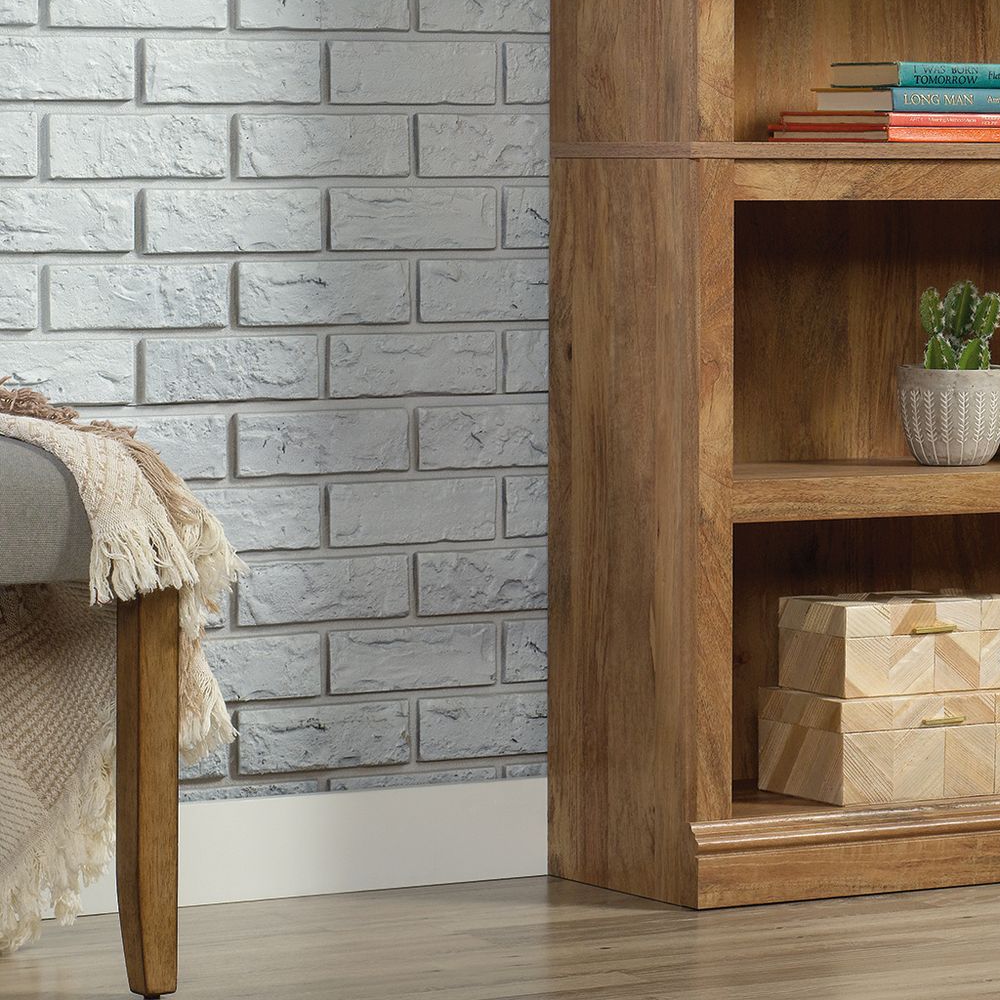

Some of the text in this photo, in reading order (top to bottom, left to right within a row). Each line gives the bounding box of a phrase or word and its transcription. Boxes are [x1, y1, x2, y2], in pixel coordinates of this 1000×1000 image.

[923, 65, 946, 74] WAS
[951, 65, 979, 75] BORN
[913, 74, 979, 85] TOMORROW
[903, 93, 975, 106] LONG MAN
